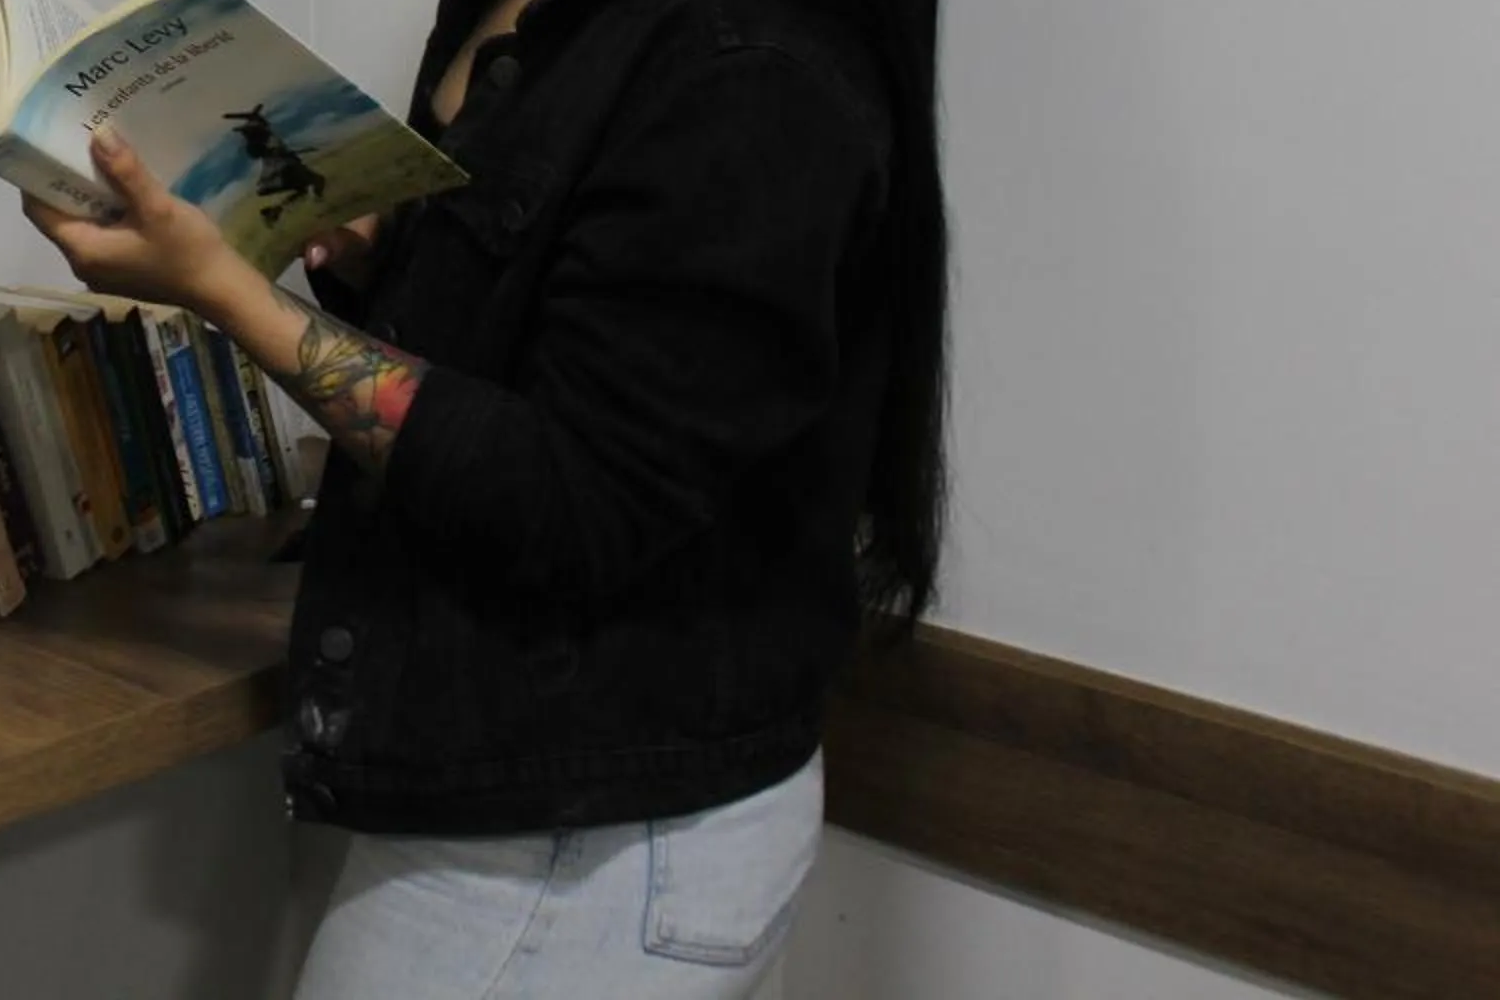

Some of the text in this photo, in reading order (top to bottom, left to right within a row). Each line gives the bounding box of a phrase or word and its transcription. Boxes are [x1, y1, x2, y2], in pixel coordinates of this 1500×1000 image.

[66, 51, 131, 97] Marc
[125, 17, 189, 54] Levy
[108, 72, 157, 109] enfants
[155, 61, 177, 77] de
